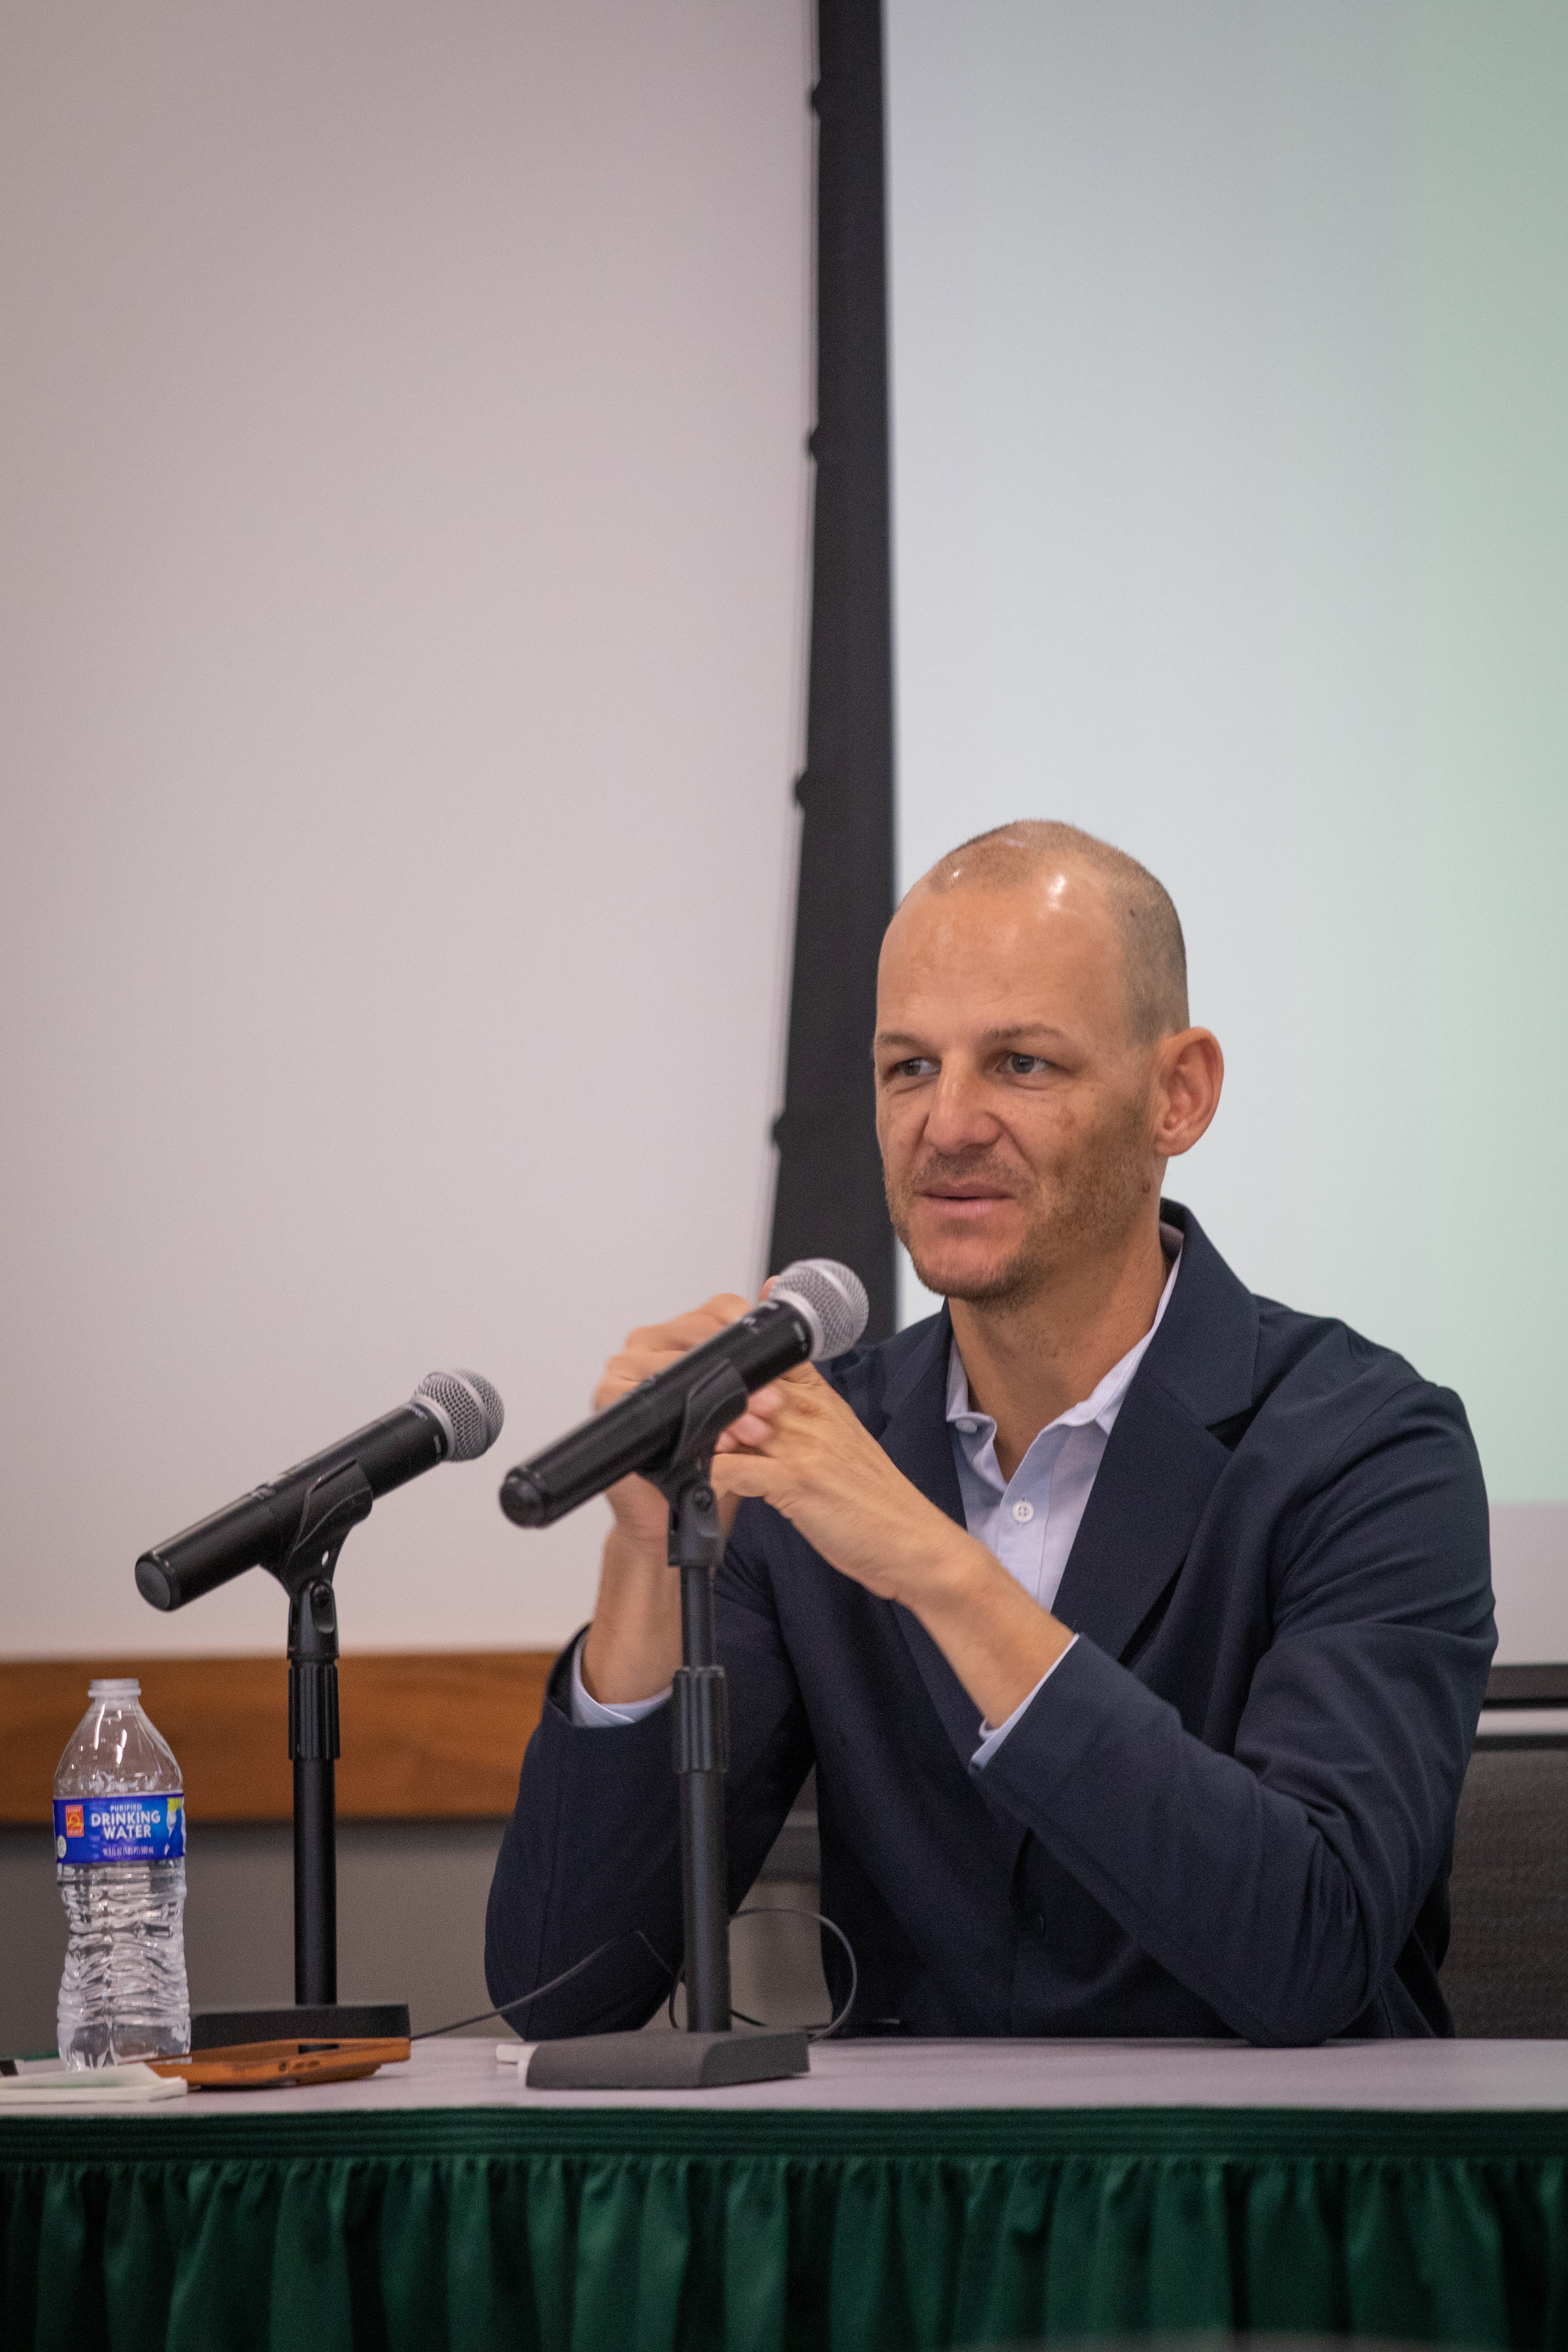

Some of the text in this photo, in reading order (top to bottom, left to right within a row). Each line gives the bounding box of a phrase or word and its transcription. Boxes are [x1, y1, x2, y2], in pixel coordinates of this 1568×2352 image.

[110, 1803, 142, 1812] PURIFIED
[91, 1809, 161, 1827] DRINKING
[103, 1824, 151, 1840] WATER
